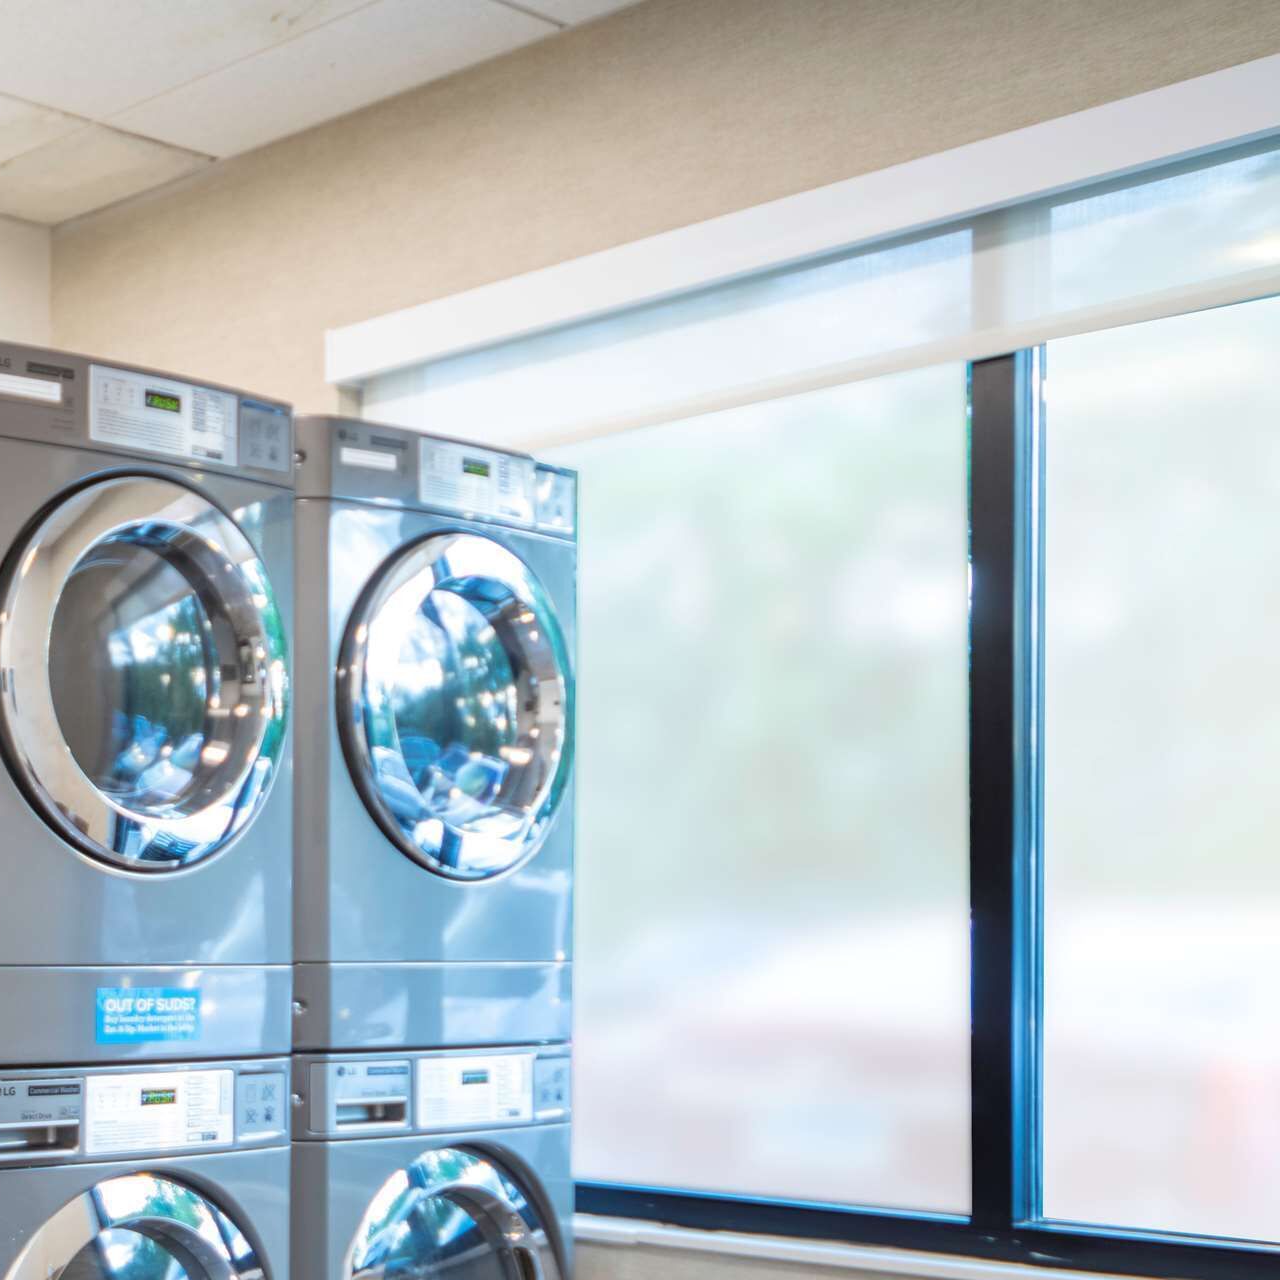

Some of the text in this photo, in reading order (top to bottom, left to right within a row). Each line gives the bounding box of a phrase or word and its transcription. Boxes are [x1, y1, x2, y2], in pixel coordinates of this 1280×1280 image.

[105, 997, 196, 1012] OUT OF SUDS?
[3, 1087, 16, 1096] LG
